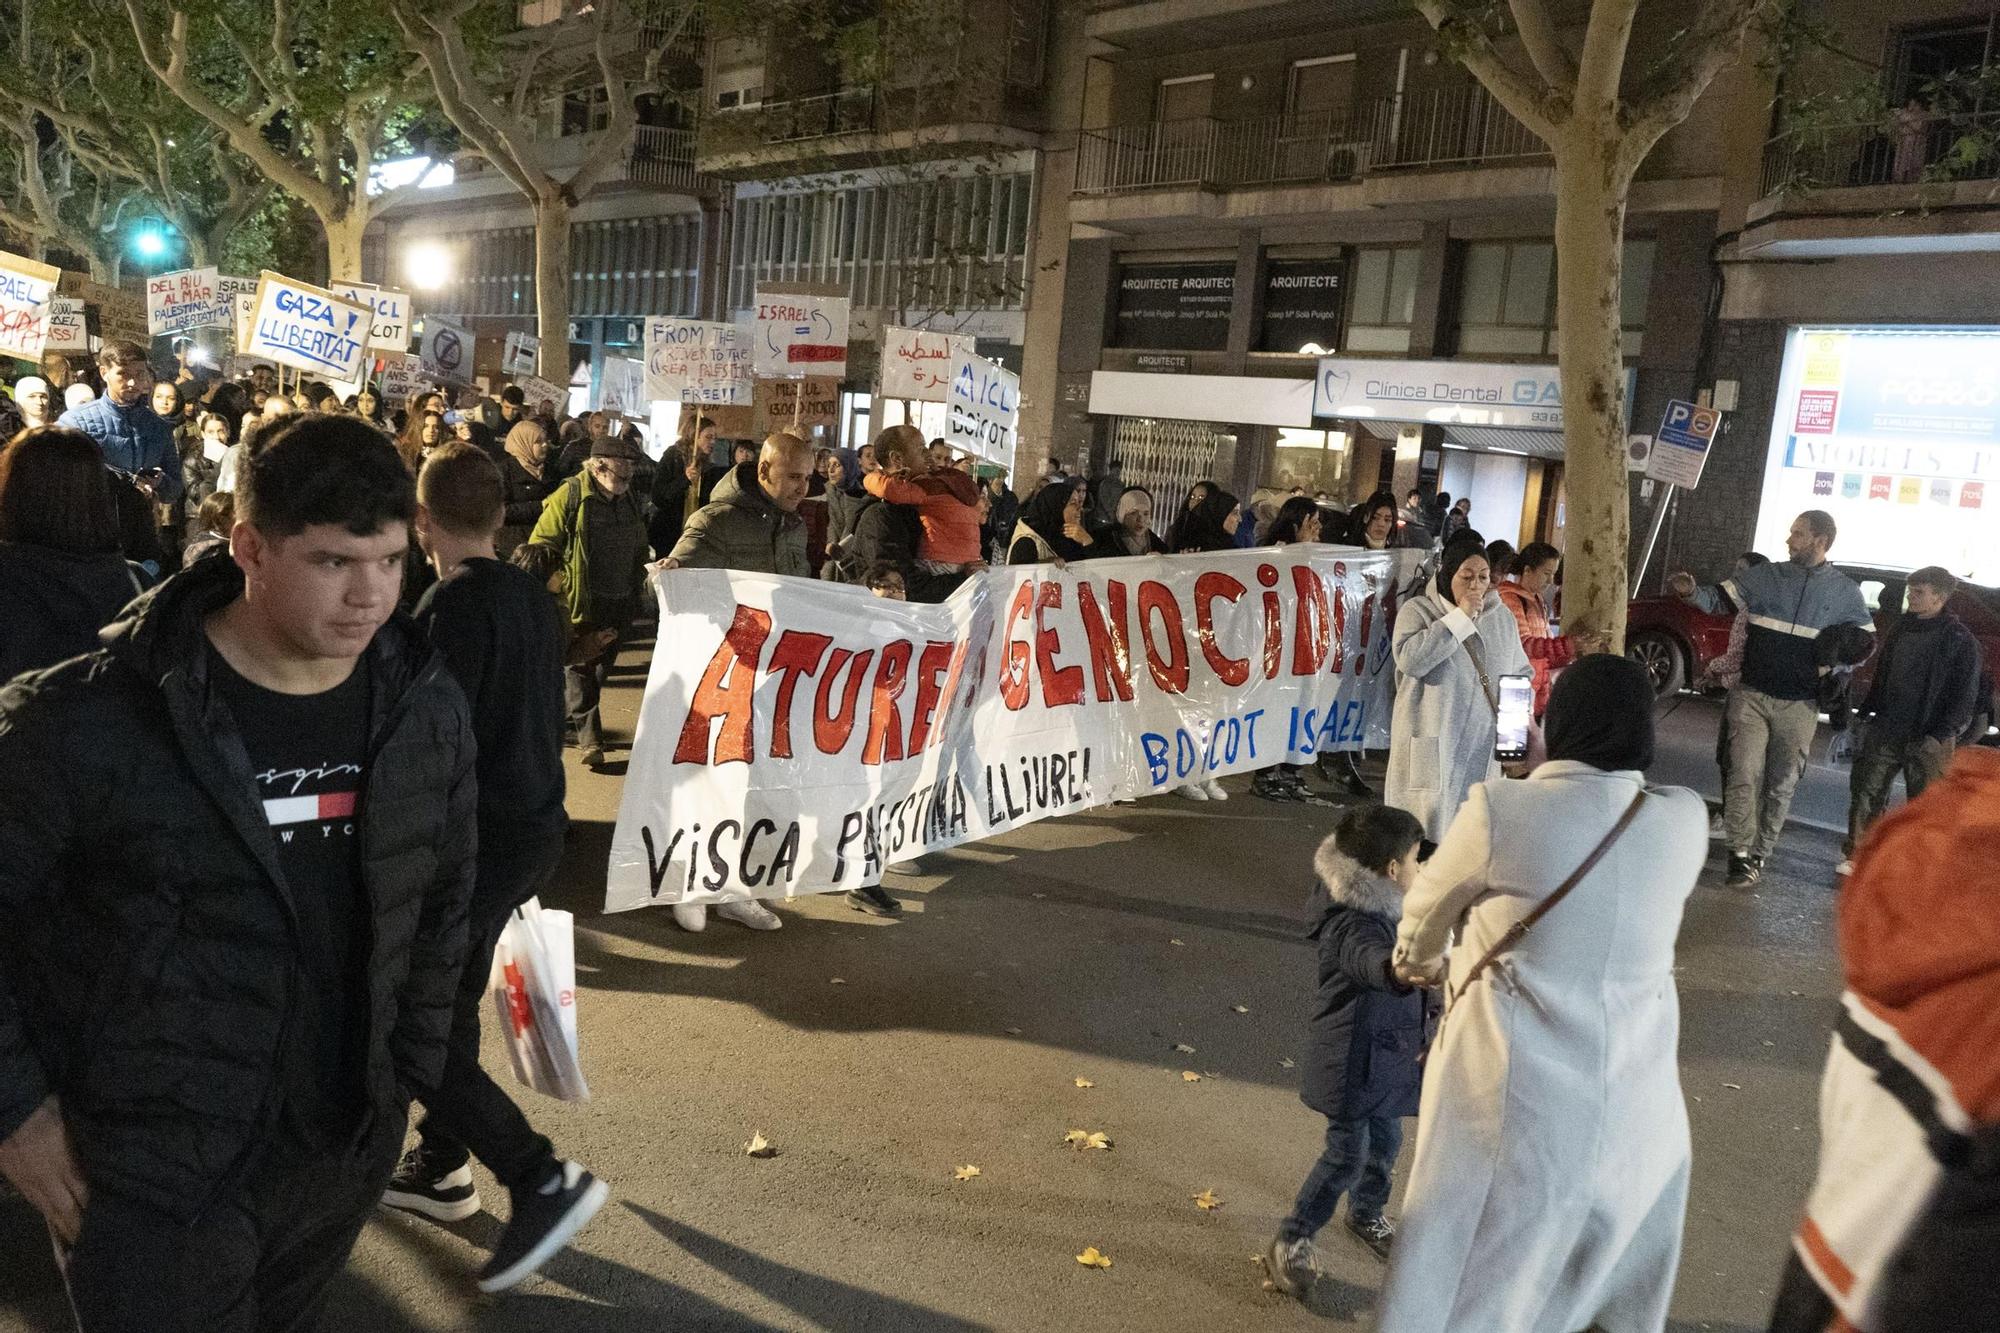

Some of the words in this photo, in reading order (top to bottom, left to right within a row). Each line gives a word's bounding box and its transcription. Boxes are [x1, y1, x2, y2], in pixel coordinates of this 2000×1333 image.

[150, 280, 176, 294] DEL
[180, 275, 202, 290] RIU
[1122, 279, 1179, 289] ARQUITECTE
[1182, 277, 1236, 288] ARQUITECT
[1270, 276, 1339, 288] ARQUITECTE
[164, 294, 179, 306] AL
[182, 287, 212, 302] MAR
[154, 300, 210, 321] PALESTINA
[758, 305, 808, 321] ISRAEL
[371, 324, 402, 339] COT
[653, 324, 704, 344] FROM
[713, 327, 737, 345] THE
[260, 318, 361, 362] LLIBERTAT
[711, 349, 724, 361] TO
[726, 349, 748, 361] THE
[898, 338, 951, 363] لسطين
[1138, 356, 1186, 367] ARQUITECTE
[662, 364, 688, 376] SEA
[682, 388, 736, 404] FREE!!
[1365, 380, 1427, 398] Clínica
[1433, 383, 1503, 401] Dental
[1513, 380, 1561, 404] GA
[1669, 405, 1689, 425] P
[1815, 479, 1833, 488] 20%
[1871, 484, 1890, 493] 40%
[1963, 490, 1981, 499] 70%
